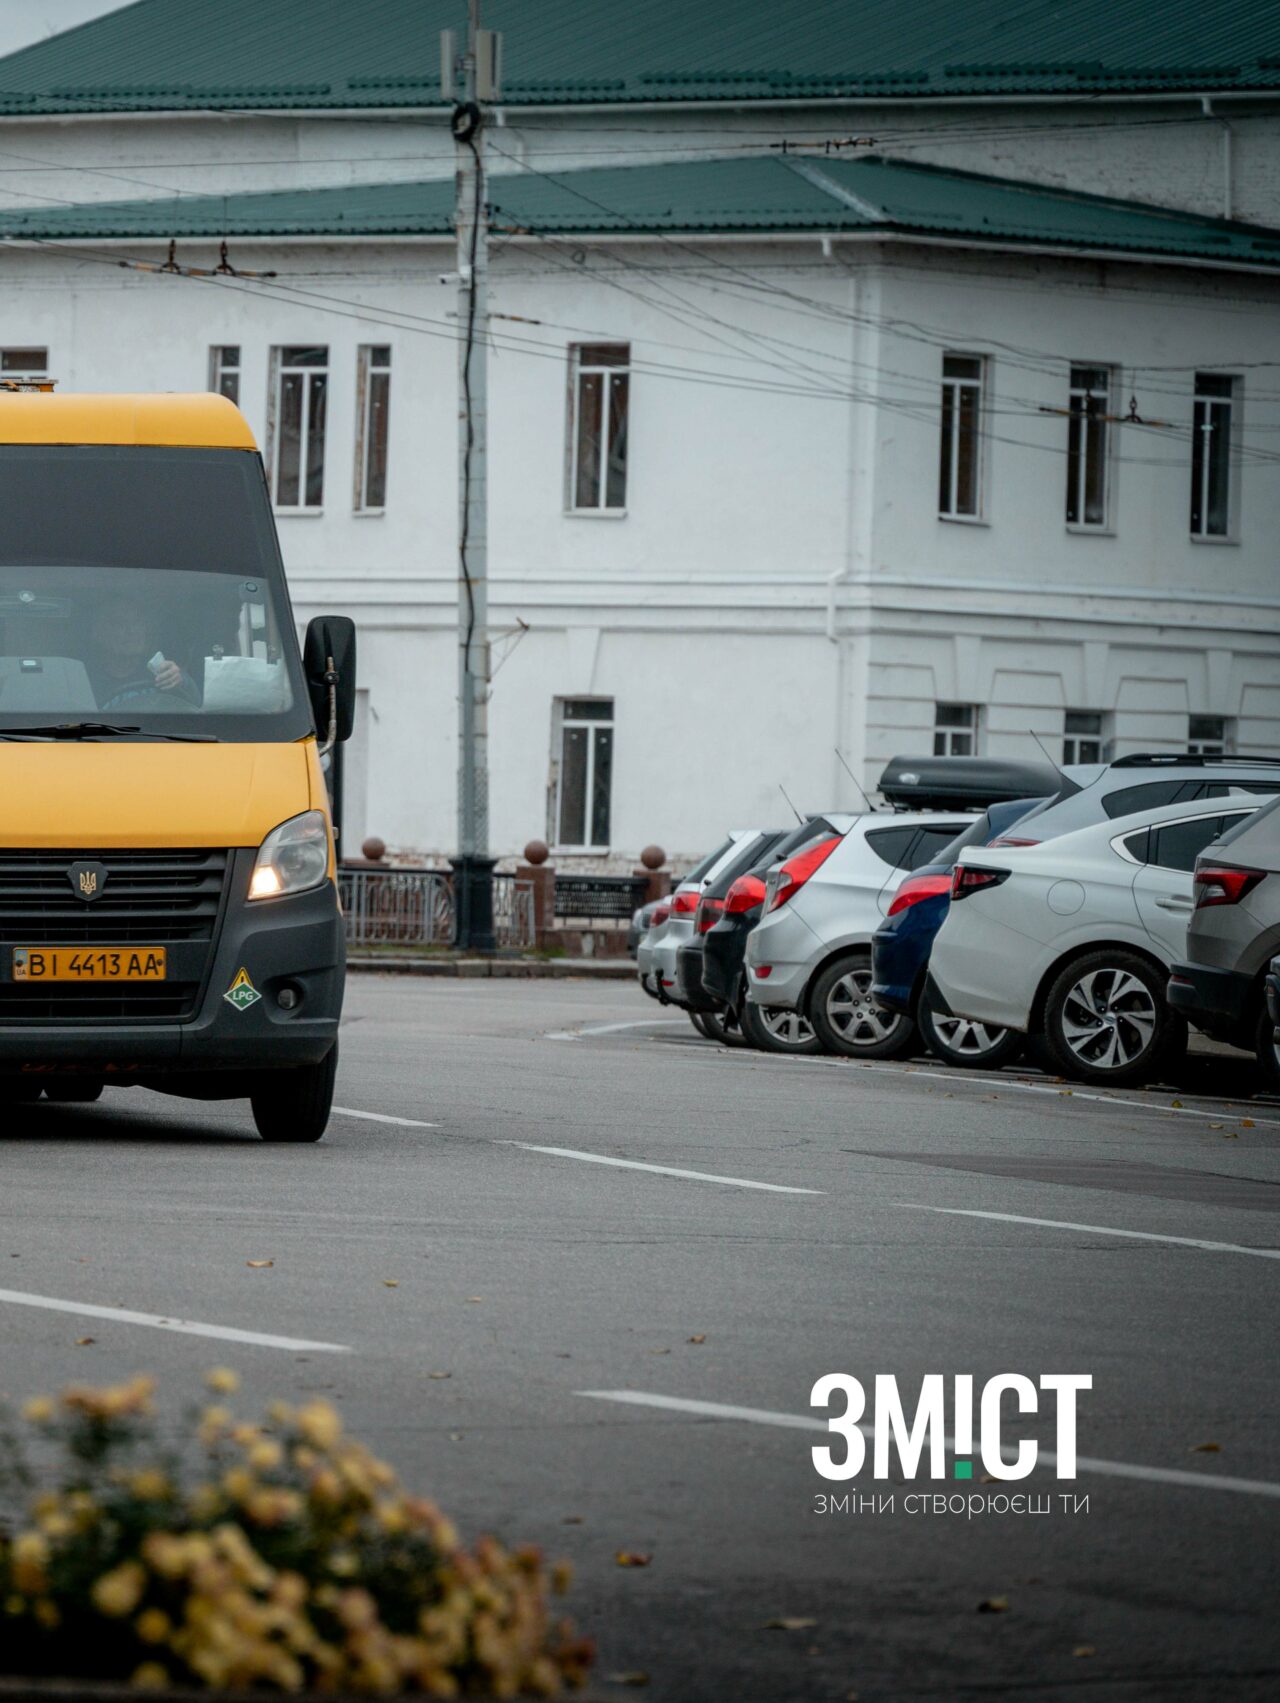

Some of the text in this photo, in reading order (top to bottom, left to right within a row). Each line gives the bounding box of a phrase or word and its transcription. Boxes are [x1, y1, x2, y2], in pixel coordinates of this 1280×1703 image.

[69, 954, 120, 976] 4413
[127, 954, 158, 976] AA
[232, 991, 254, 1001] LPG
